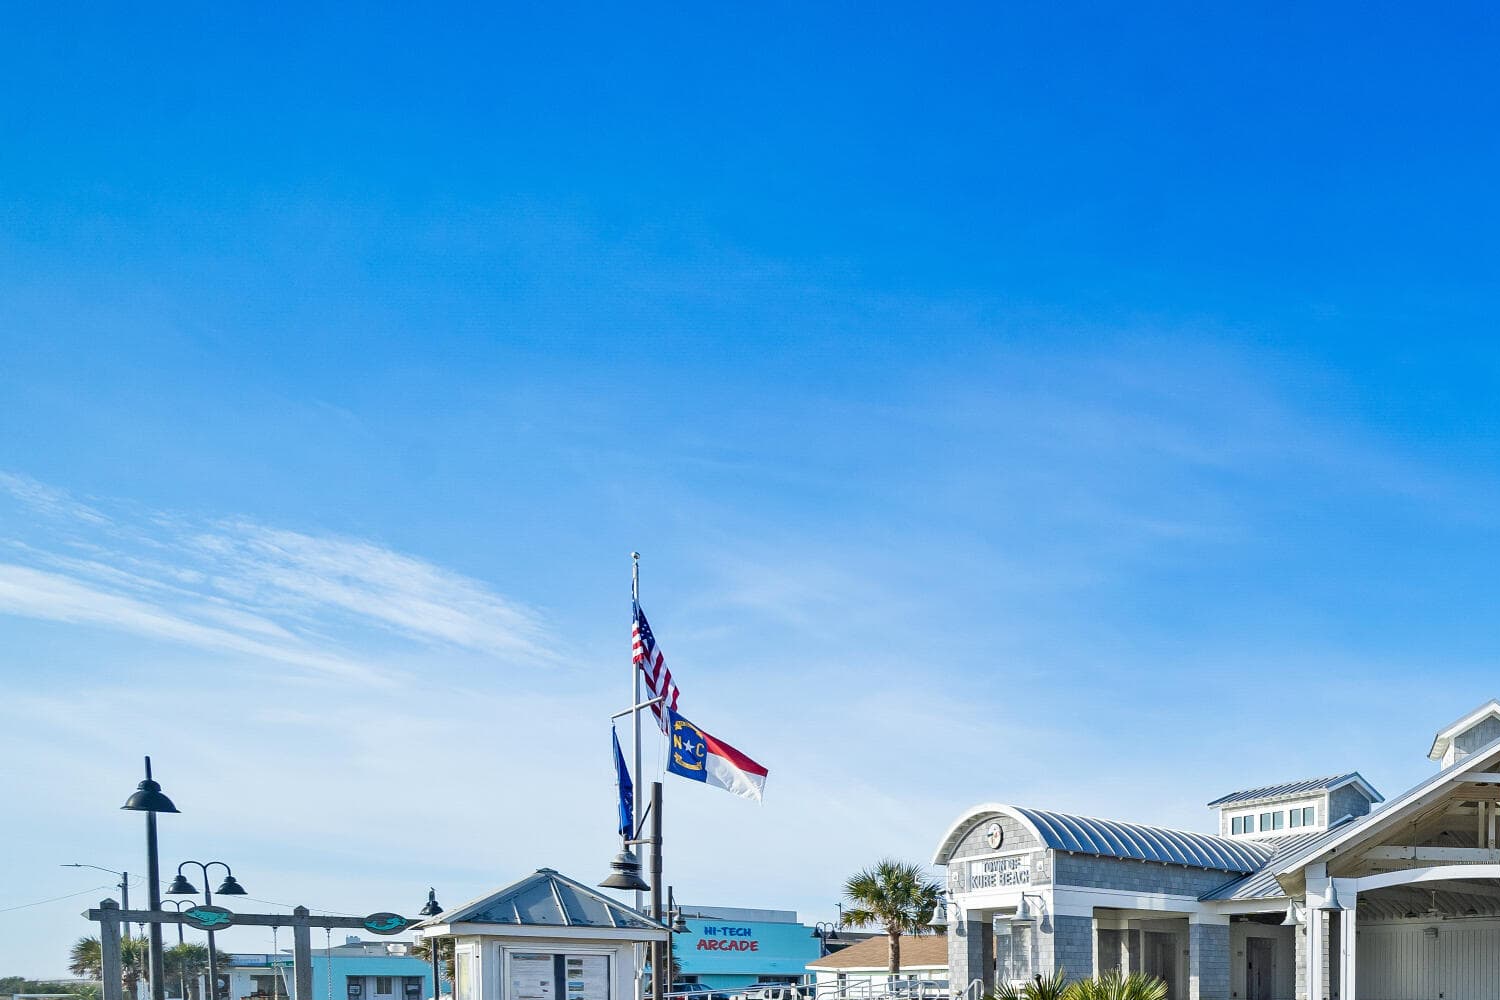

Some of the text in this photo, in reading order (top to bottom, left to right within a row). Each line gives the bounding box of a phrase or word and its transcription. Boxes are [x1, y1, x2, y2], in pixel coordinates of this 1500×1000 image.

[673, 734, 704, 757] N C
[984, 857, 1021, 873] TOWN OF
[971, 870, 1029, 889] KURE BEACH
[704, 926, 752, 937] HI-TECH
[696, 939, 759, 952] ARCADE
